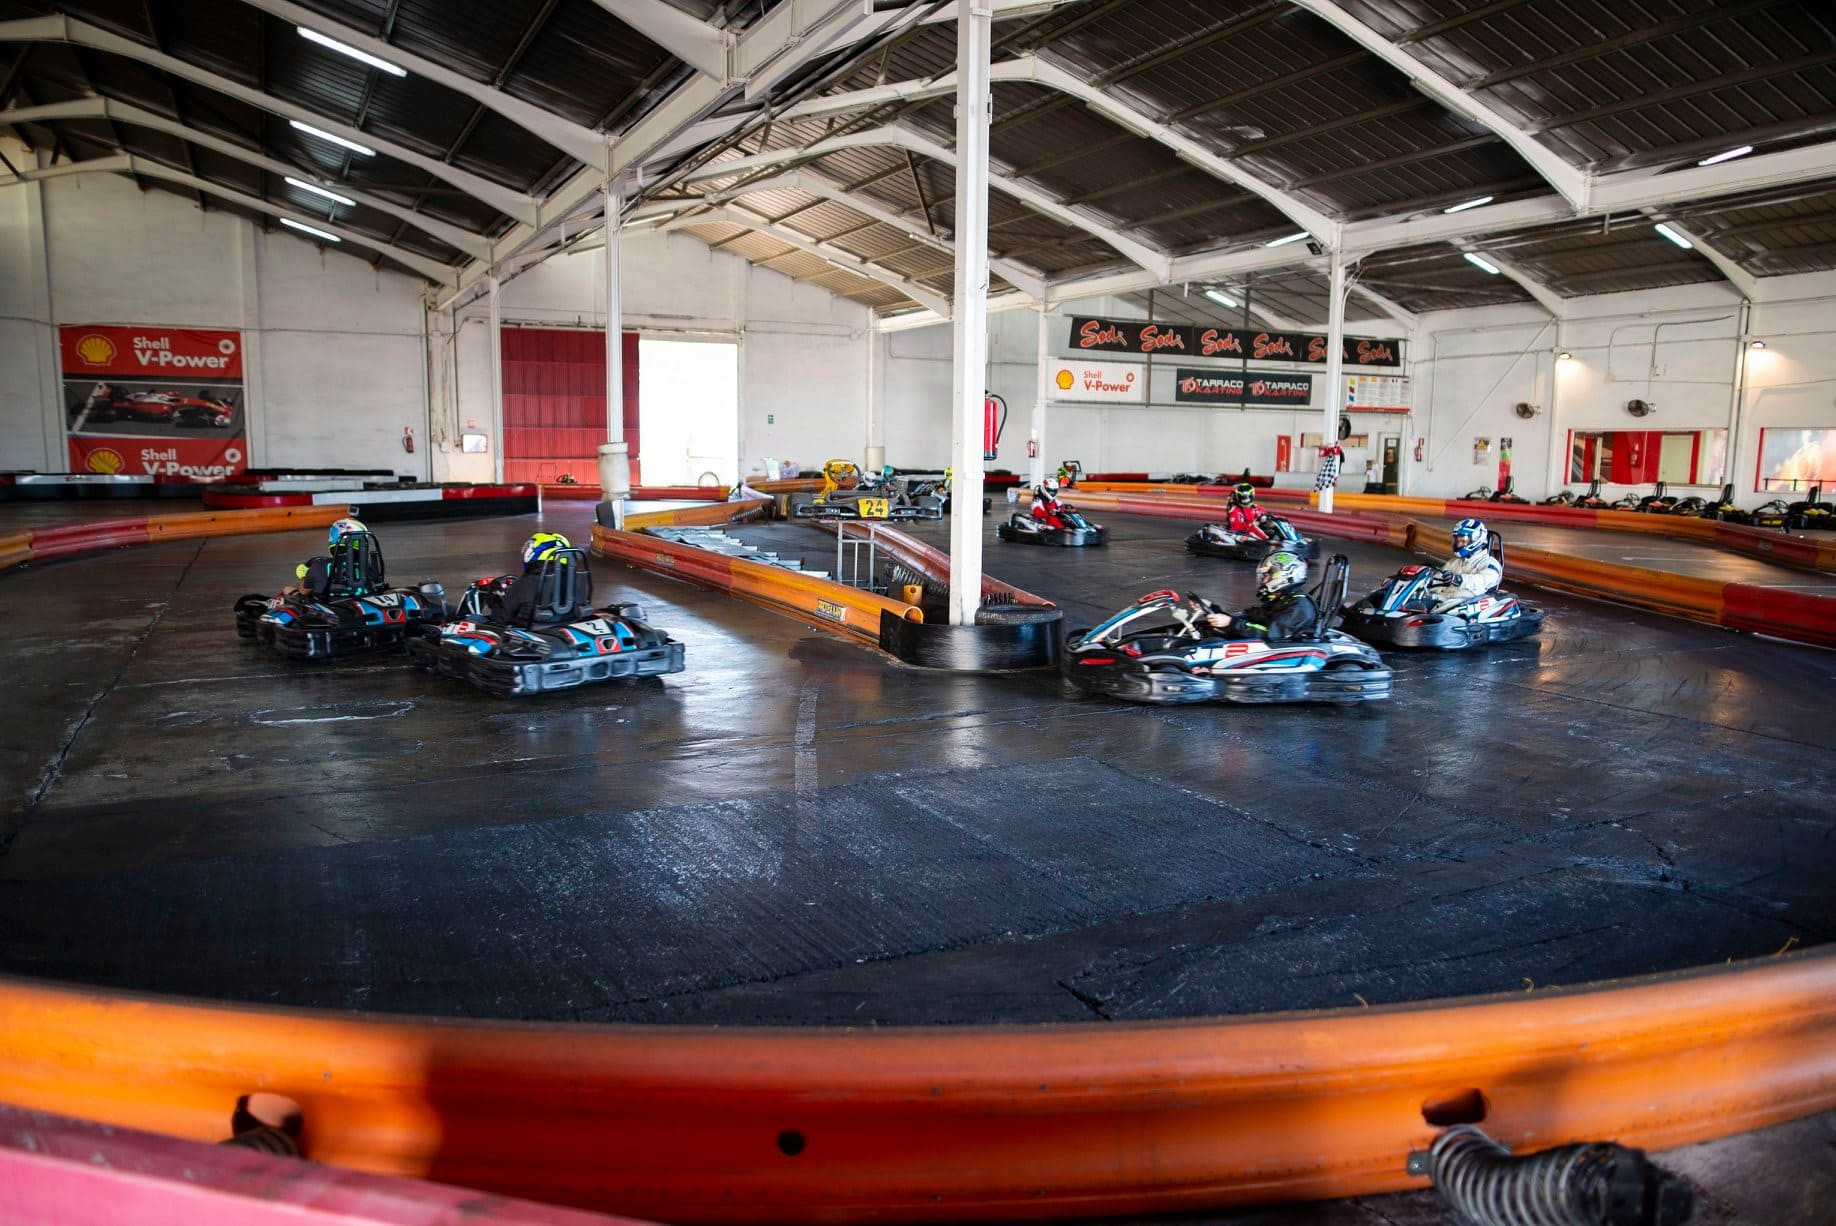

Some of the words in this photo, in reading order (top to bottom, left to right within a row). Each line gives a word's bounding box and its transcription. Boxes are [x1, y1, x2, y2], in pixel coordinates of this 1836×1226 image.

[133, 337, 170, 349] Shell
[1080, 320, 1127, 348] Sodi
[1140, 325, 1184, 352] Sodi
[1201, 329, 1242, 355] Sodi
[1253, 333, 1293, 358] Sodi
[1357, 341, 1393, 363] Sodi
[134, 350, 229, 368] V-Power
[1084, 370, 1102, 379] Shell
[1084, 380, 1131, 392] V-Power
[1196, 379, 1244, 388] TARRACO
[1265, 381, 1310, 390] TARRACO
[1195, 387, 1243, 395] KARTING
[1264, 389, 1308, 397] KARTING
[141, 448, 176, 460] Shell
[142, 462, 235, 476] V-Power
[865, 500, 884, 516] 24
